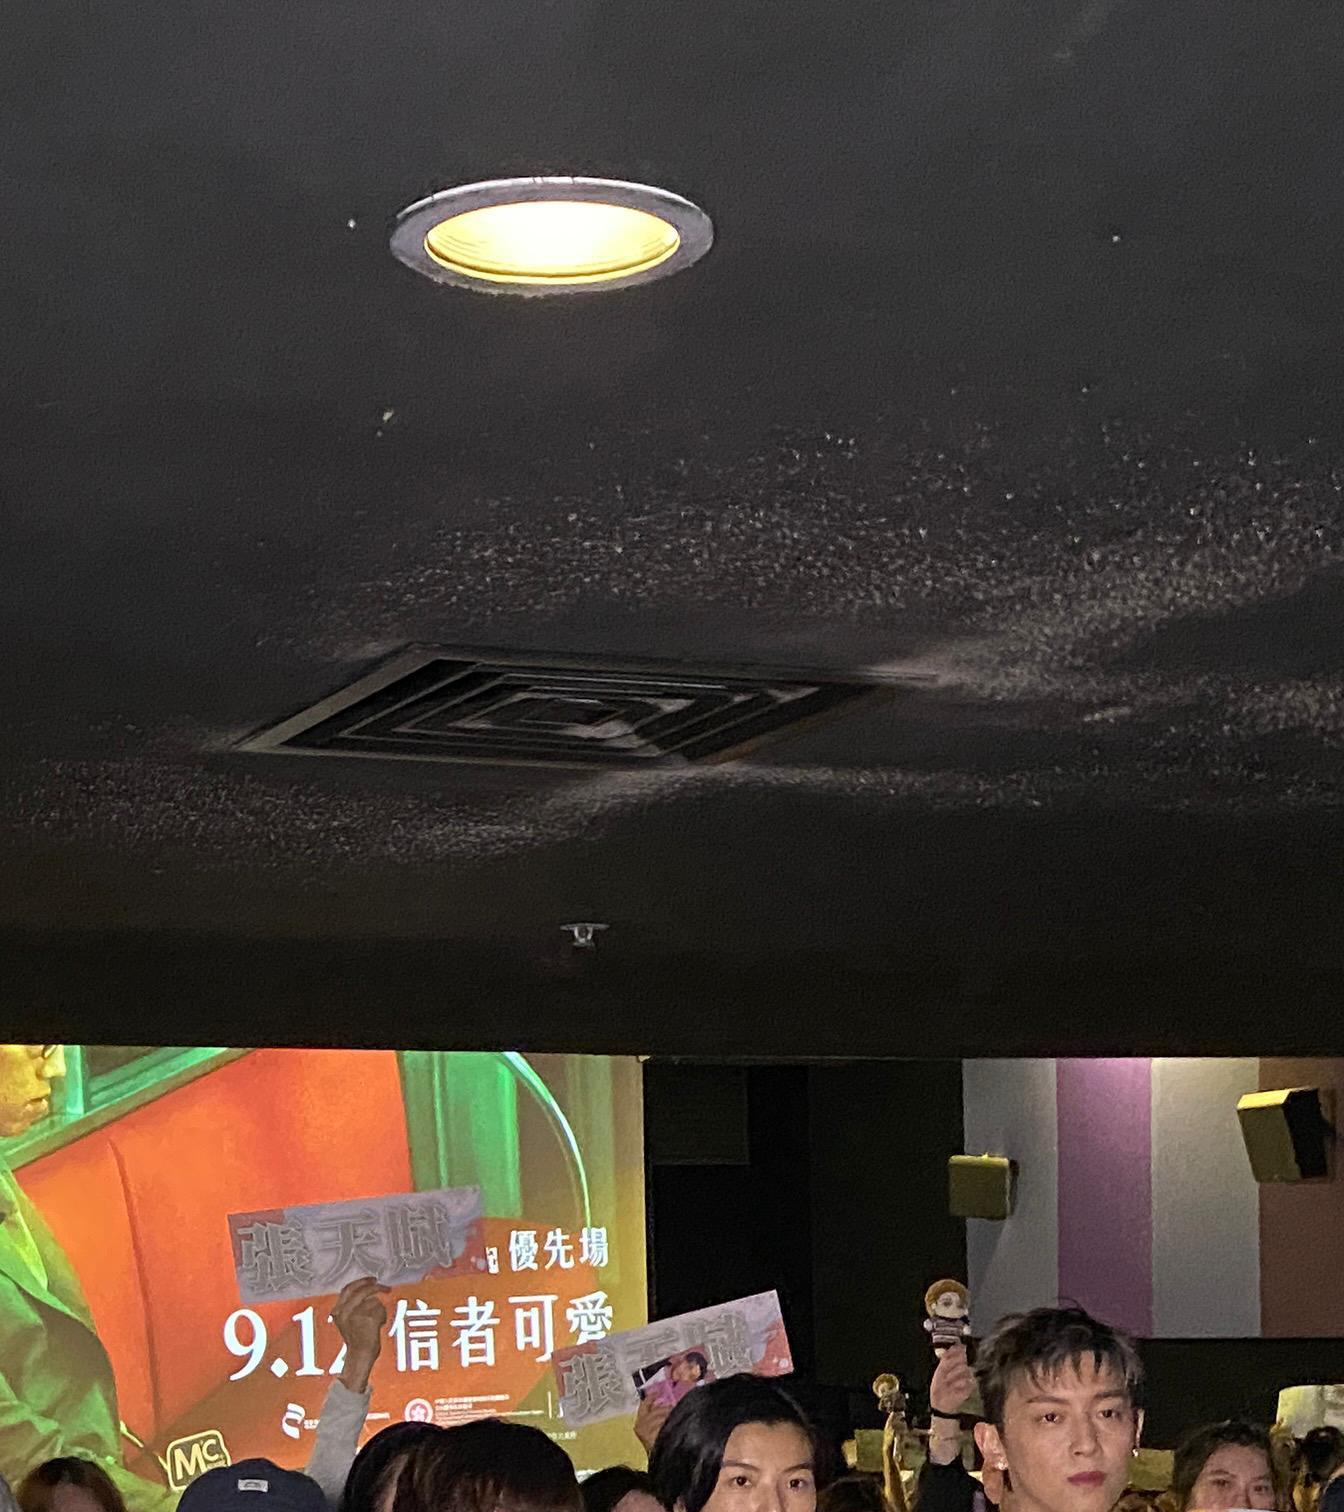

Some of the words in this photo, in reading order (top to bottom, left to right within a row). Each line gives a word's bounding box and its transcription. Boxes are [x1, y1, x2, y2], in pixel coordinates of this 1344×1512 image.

[236, 1200, 453, 1293] 張天賦
[223, 1306, 350, 1381] 9.1
[388, 1290, 613, 1373] 信者可愛
